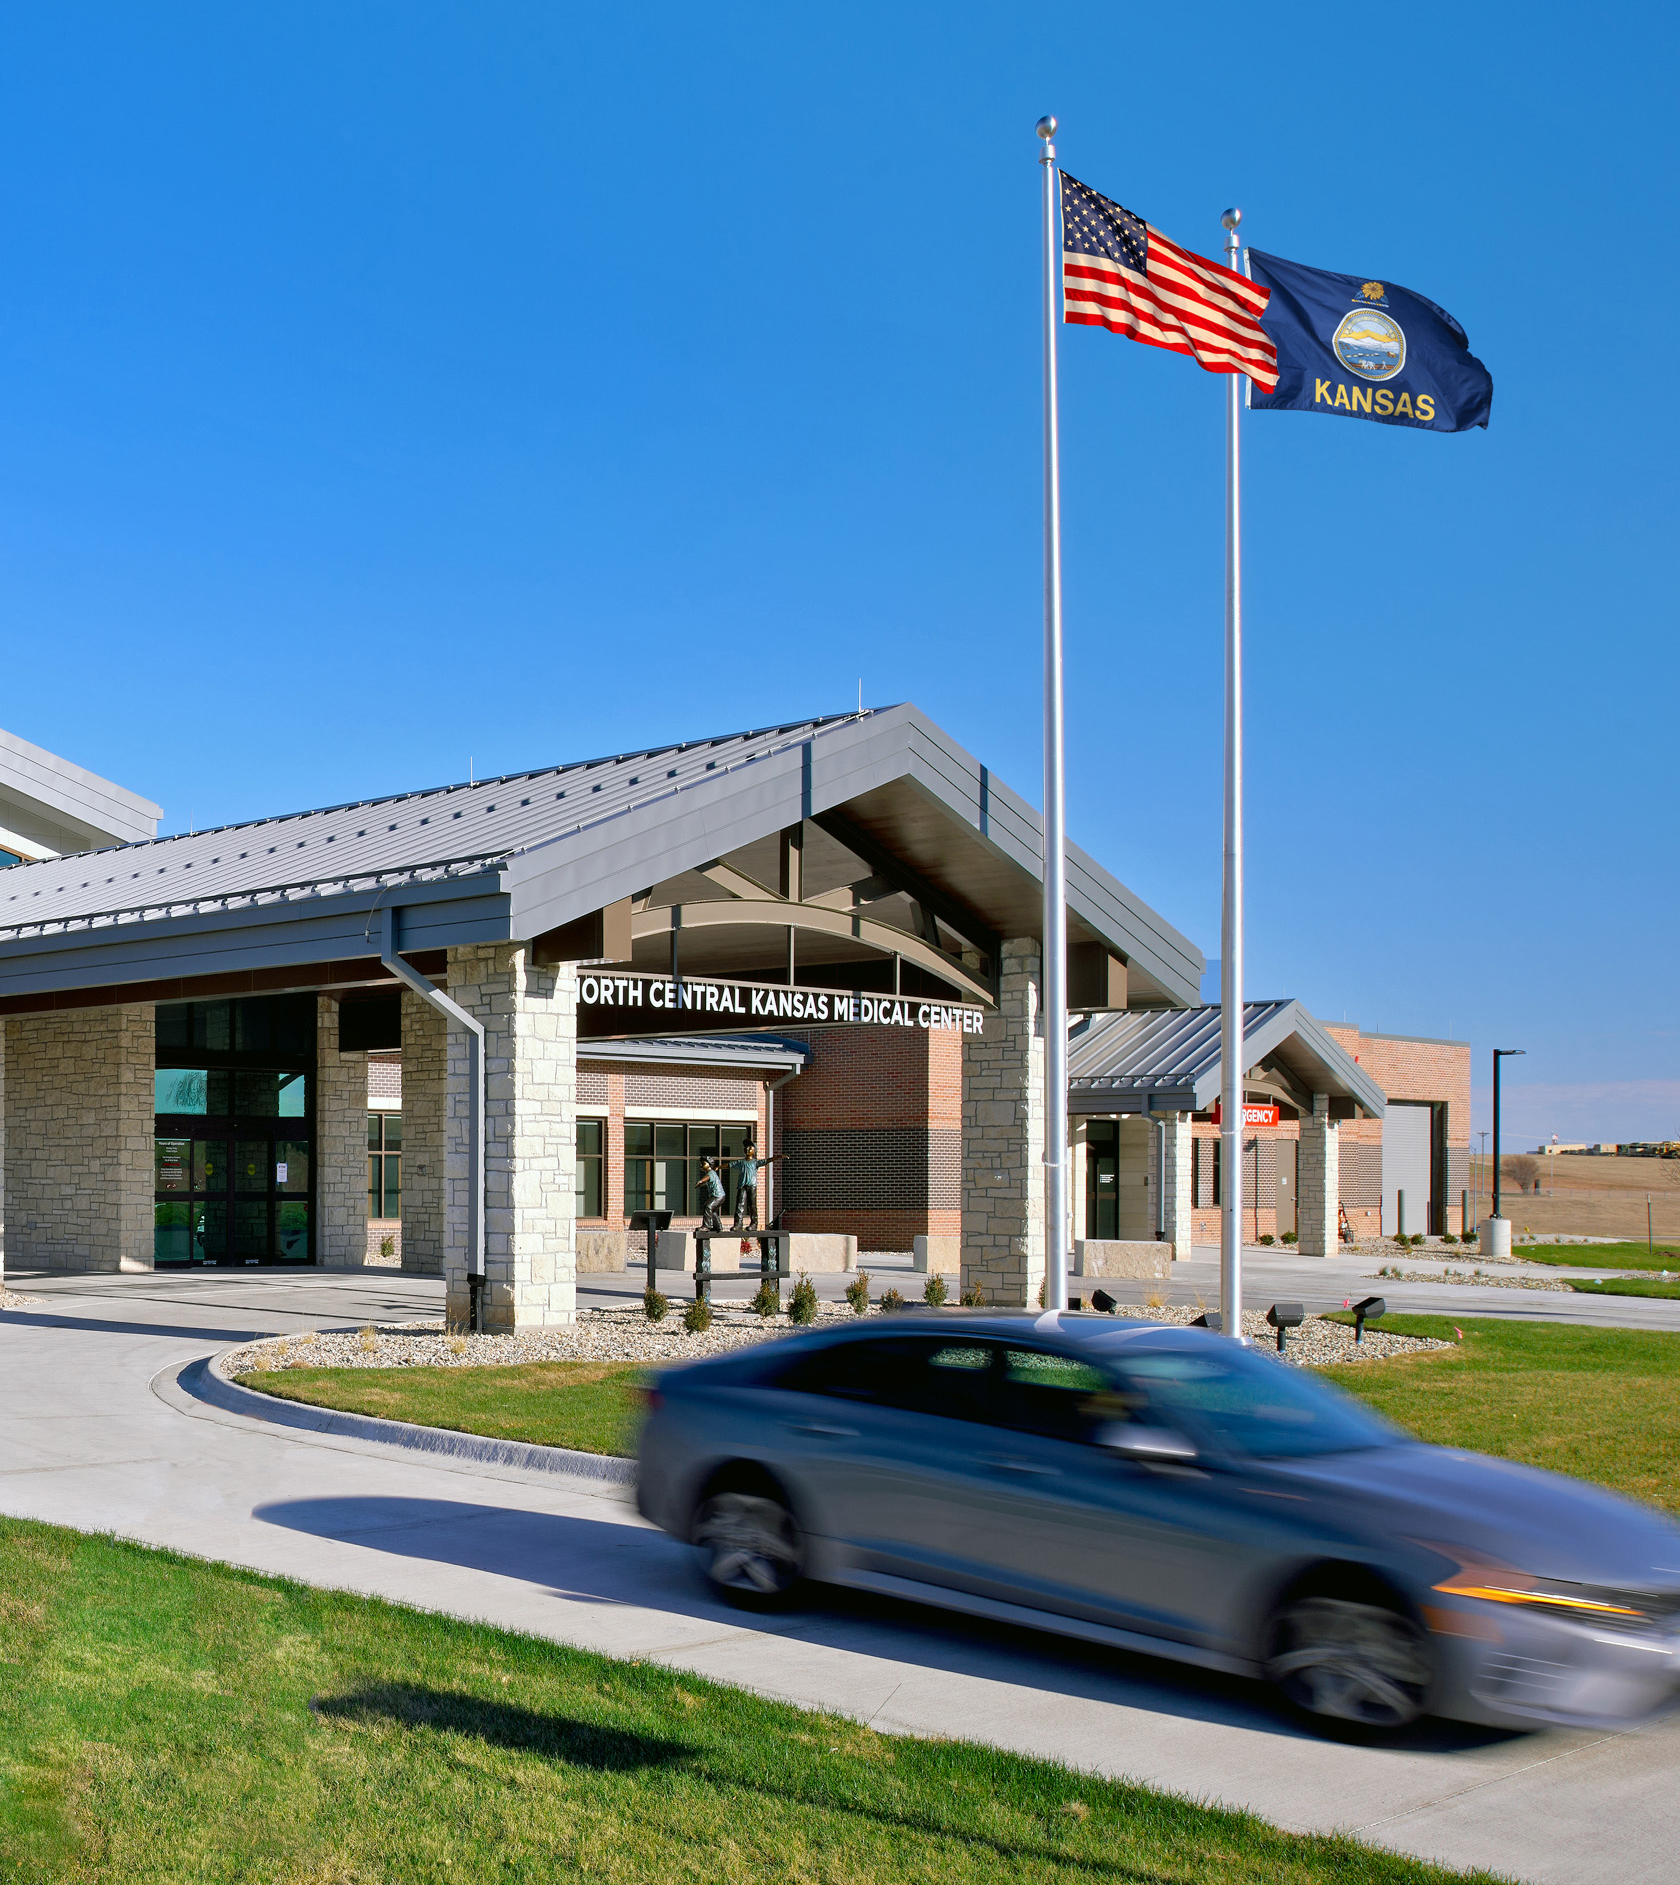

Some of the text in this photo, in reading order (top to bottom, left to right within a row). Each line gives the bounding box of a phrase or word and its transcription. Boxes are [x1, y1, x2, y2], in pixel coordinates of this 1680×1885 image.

[1315, 378, 1436, 421] KANSAS
[649, 982, 746, 1014] CENTRAL
[751, 989, 829, 1020] KANSAS
[834, 996, 914, 1027] MEDICAL
[918, 1005, 984, 1035] CENTER
[1242, 1109, 1274, 1123] RGENCY
